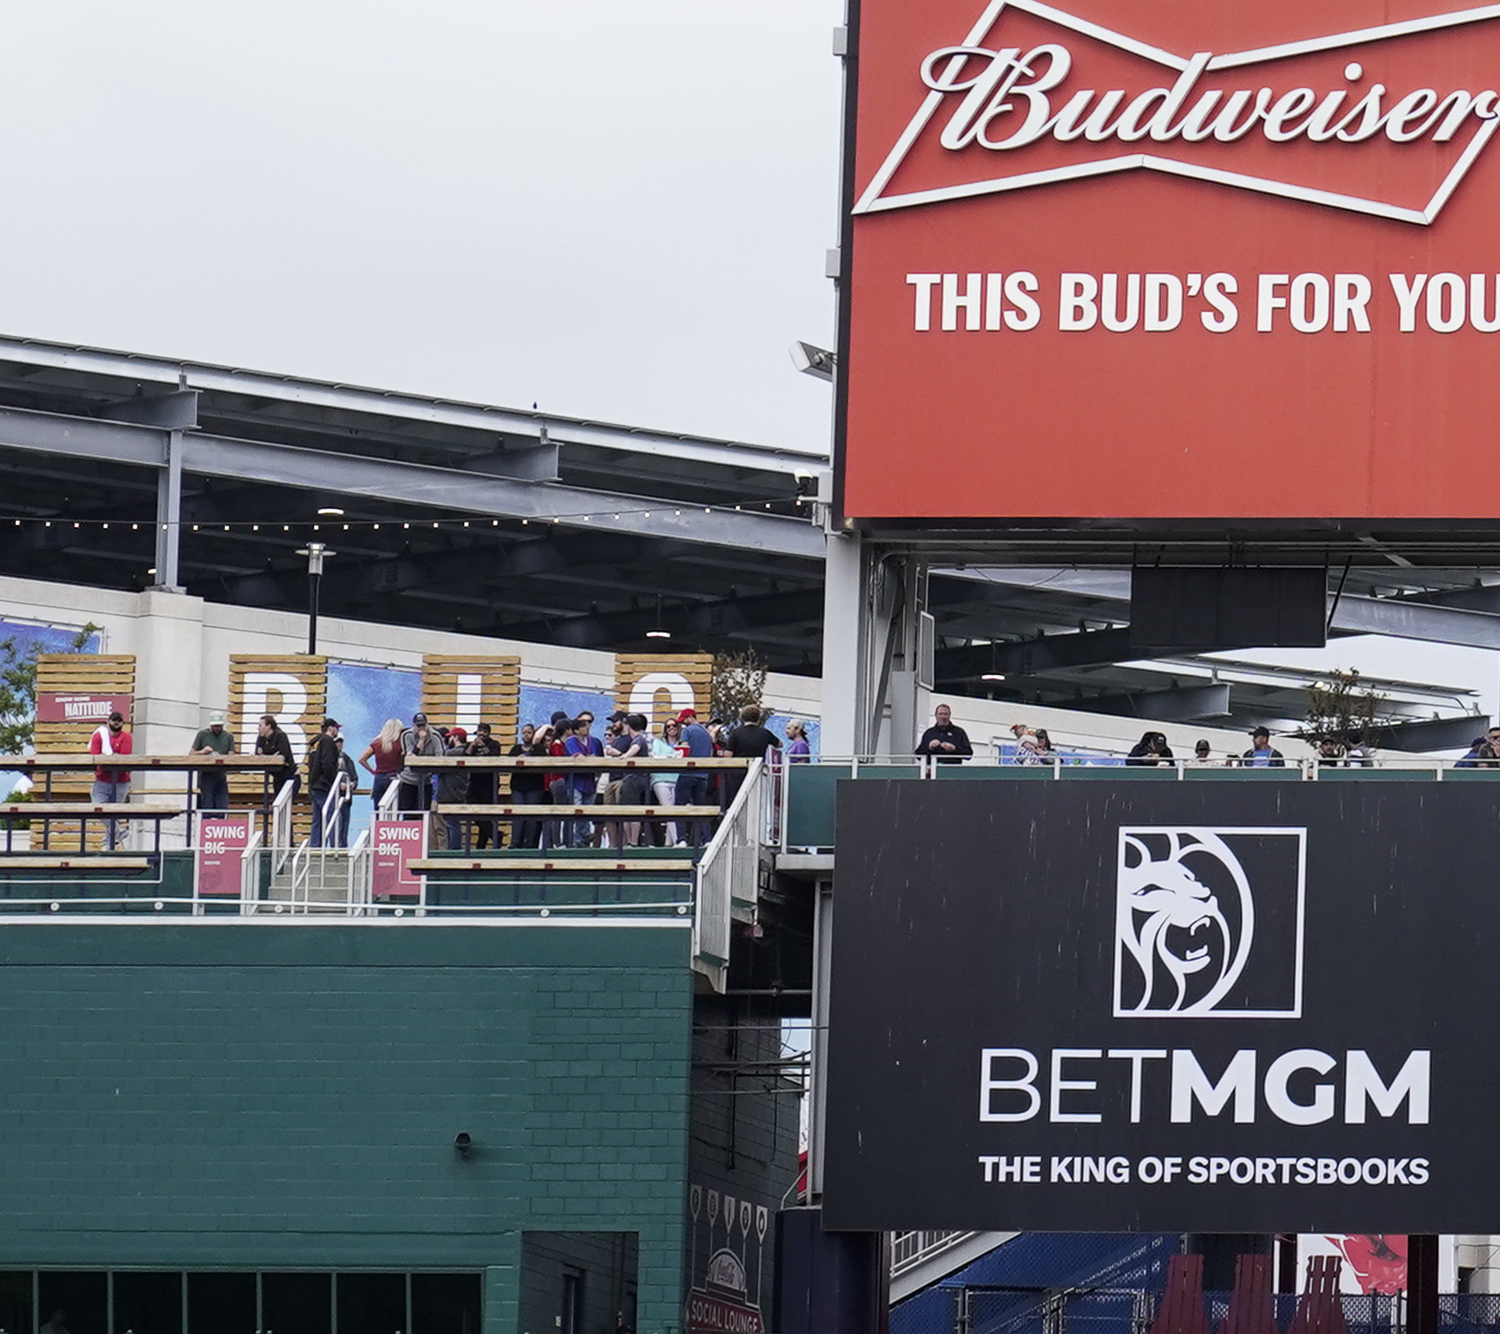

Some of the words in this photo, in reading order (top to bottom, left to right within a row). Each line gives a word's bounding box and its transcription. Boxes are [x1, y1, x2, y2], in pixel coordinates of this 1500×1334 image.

[906, 272, 1041, 332] THIS
[1256, 273, 1372, 333] FOR
[204, 825, 246, 840] SWING
[378, 826, 420, 841] SWING
[204, 840, 226, 855] BIG
[378, 842, 400, 856] BIG
[979, 1048, 1431, 1126] BETMGM
[978, 1156, 1042, 1184] THE
[1050, 1156, 1129, 1185] KING
[1138, 1156, 1183, 1185] OF
[1186, 1156, 1430, 1186] SPORTSBOOKS
